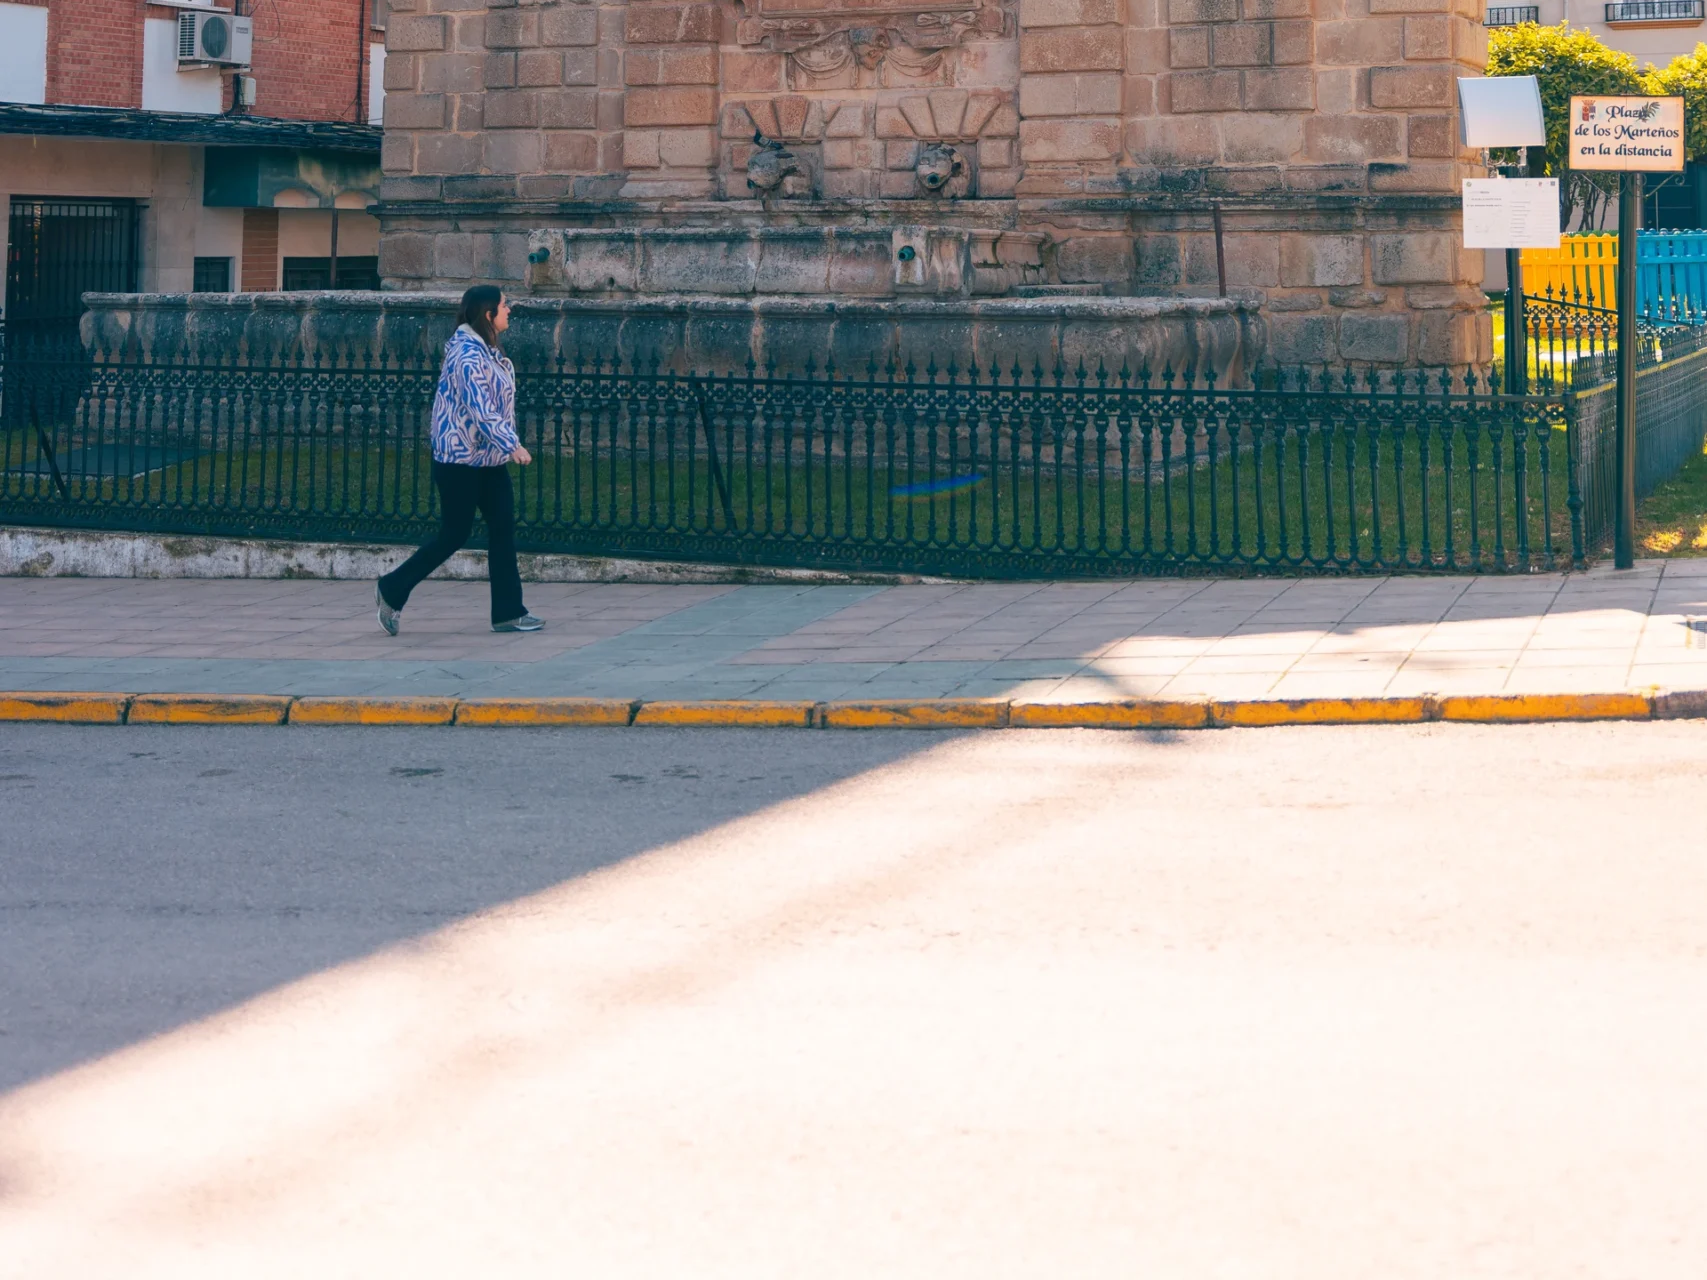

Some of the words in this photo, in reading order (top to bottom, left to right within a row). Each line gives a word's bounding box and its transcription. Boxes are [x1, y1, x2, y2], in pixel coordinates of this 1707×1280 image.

[1605, 105, 1649, 122] Plaza
[1574, 124, 1589, 136] de
[1593, 123, 1611, 136] los
[1614, 124, 1679, 140] Marteños
[1580, 146, 1595, 155] en
[1599, 142, 1611, 155] la
[1615, 143, 1673, 157] distancia
